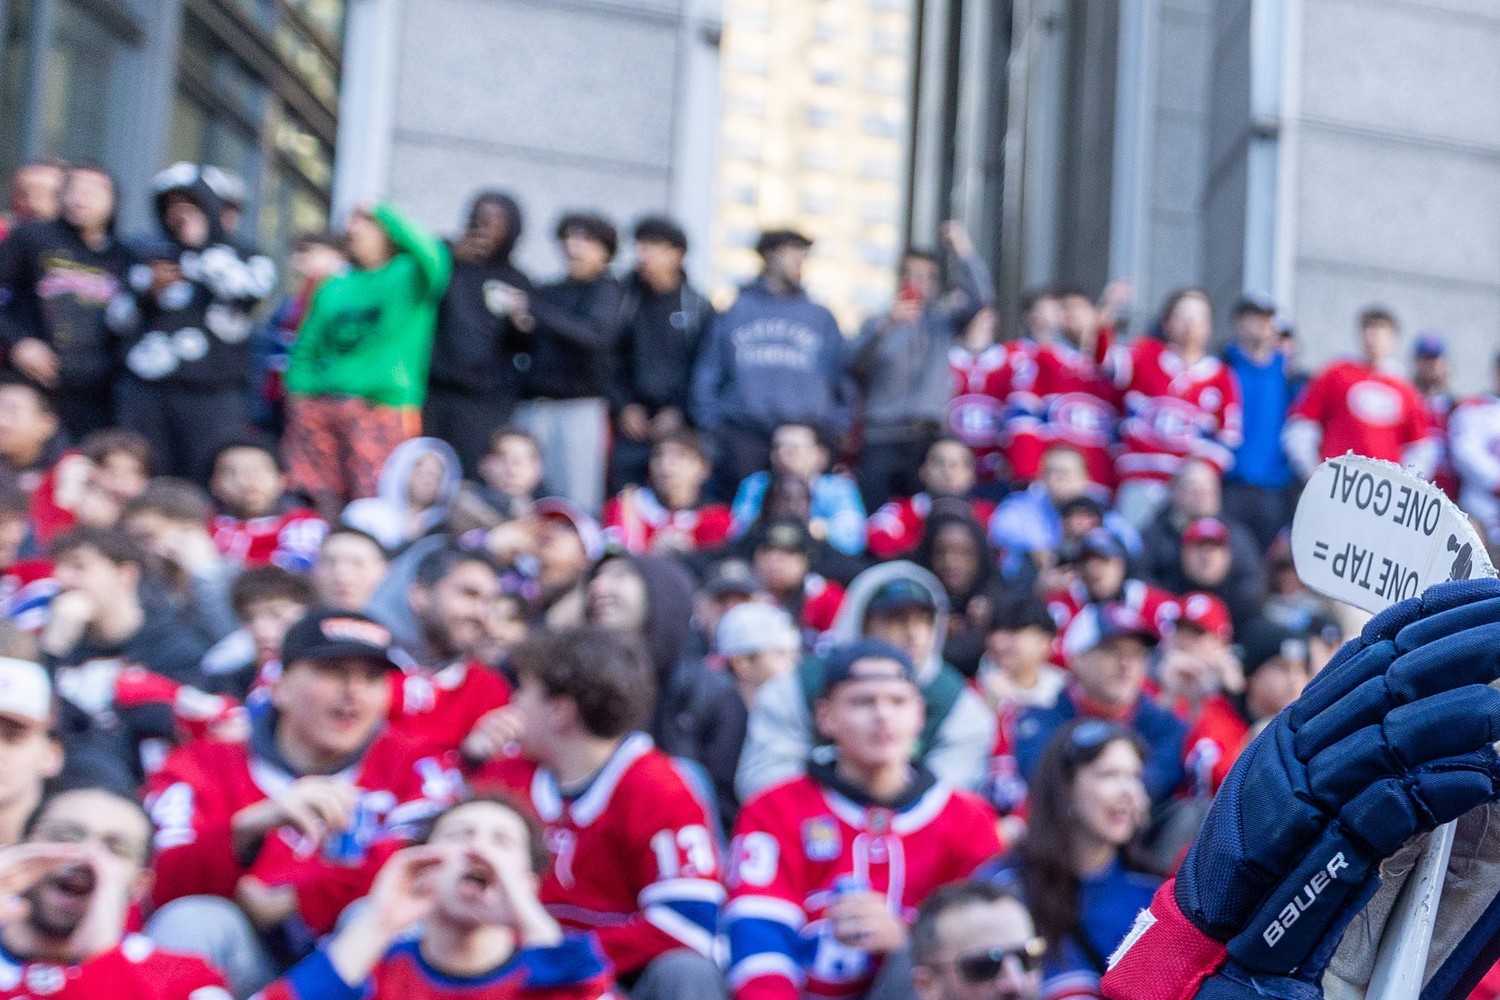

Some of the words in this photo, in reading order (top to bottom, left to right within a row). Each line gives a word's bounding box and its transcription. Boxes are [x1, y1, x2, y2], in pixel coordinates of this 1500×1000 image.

[1328, 462, 1393, 517] GOAL
[1393, 485, 1442, 536] ONE
[1331, 542, 1374, 590] TAP
[1374, 557, 1420, 602] ONE
[1262, 851, 1350, 948] BAUER
